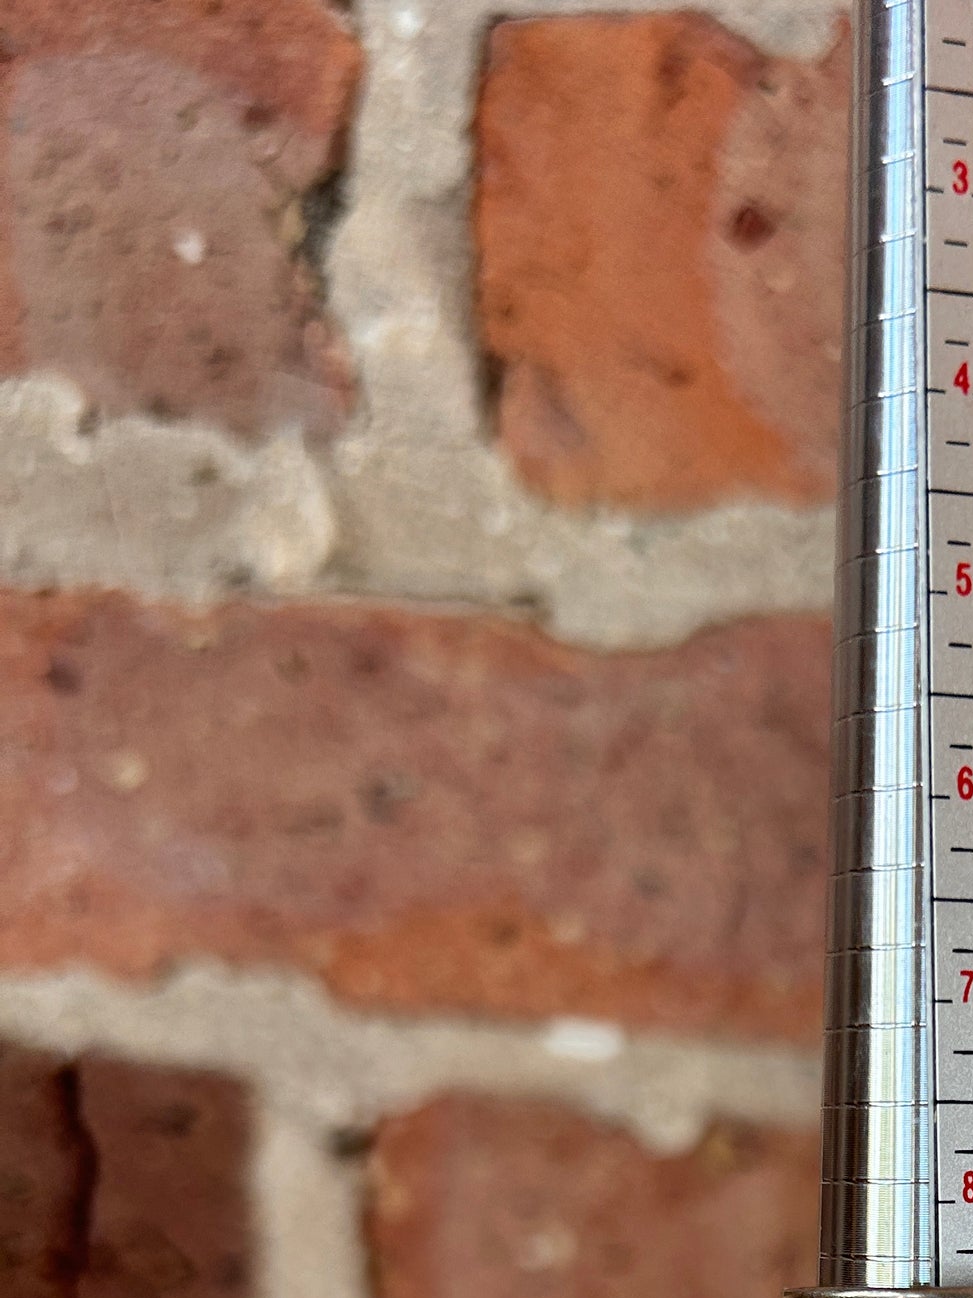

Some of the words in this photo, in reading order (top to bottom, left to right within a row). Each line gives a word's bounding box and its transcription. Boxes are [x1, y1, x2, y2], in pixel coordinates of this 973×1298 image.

[951, 158, 971, 196] 3
[952, 360, 972, 396] 4
[955, 561, 973, 597] 5
